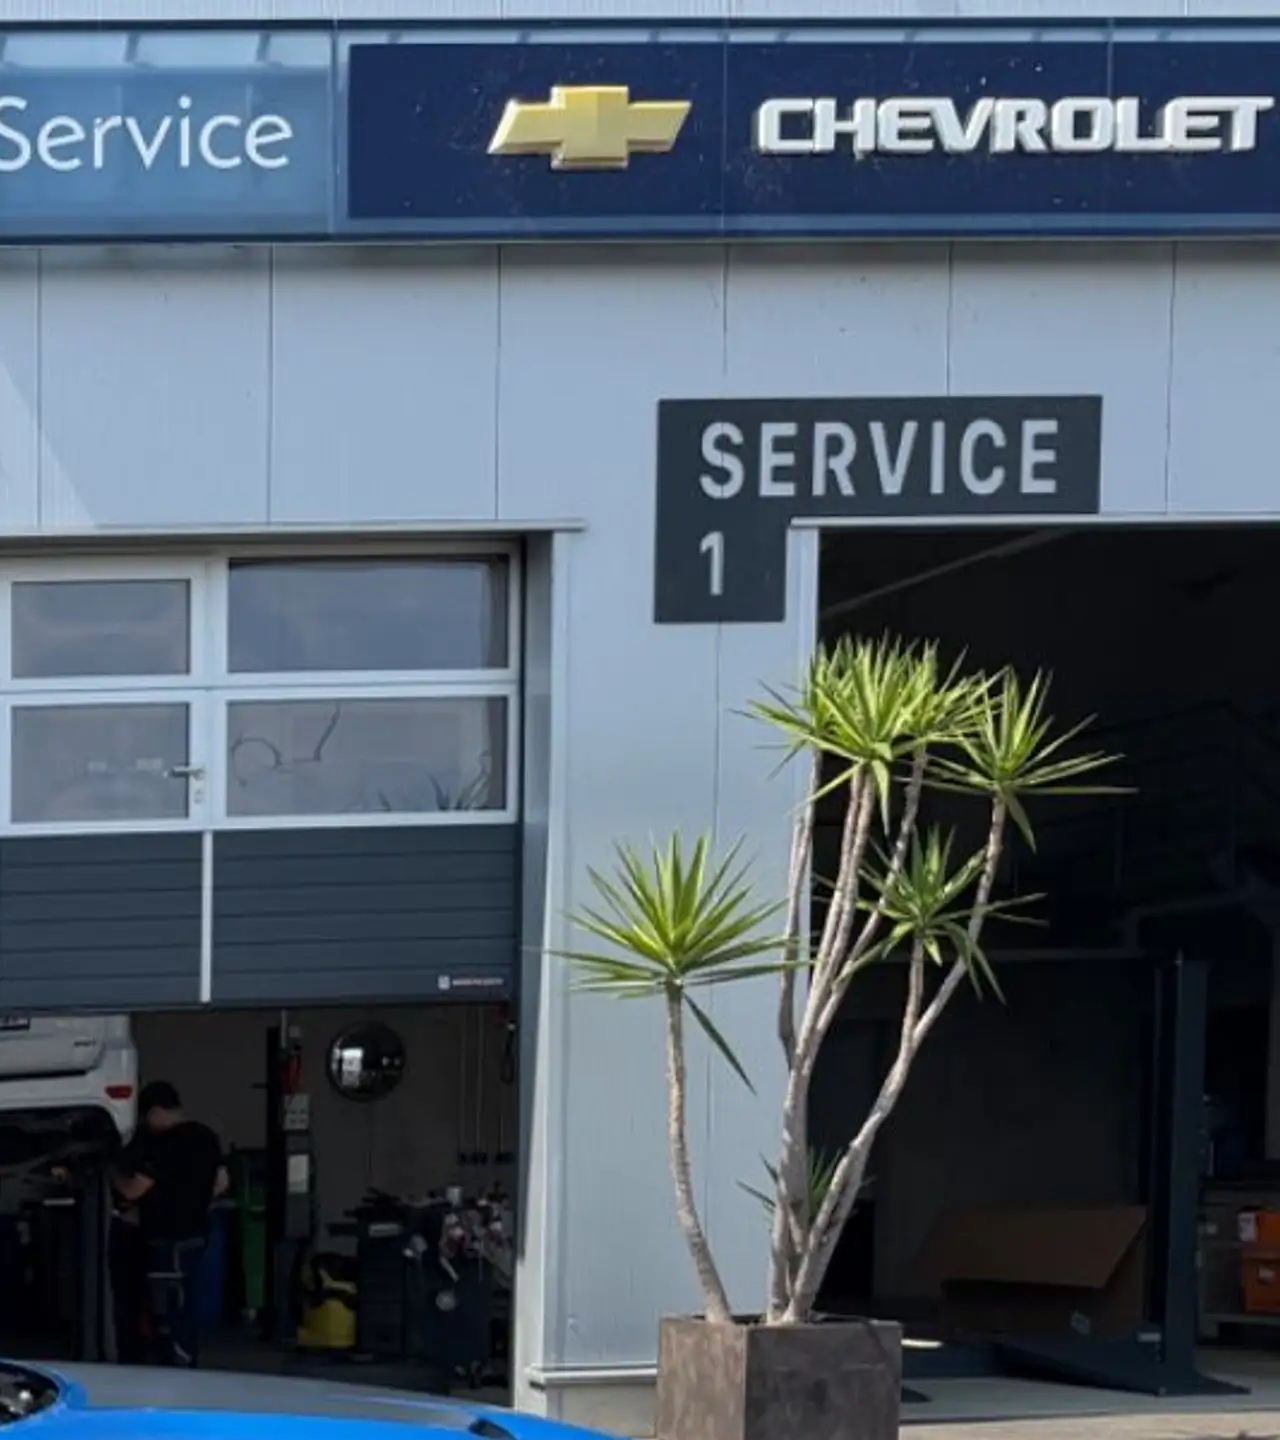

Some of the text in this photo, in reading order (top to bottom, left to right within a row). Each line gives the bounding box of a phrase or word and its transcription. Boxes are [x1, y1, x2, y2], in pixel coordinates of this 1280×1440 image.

[755, 96, 1276, 154] CHEVROLET
[698, 418, 1059, 499] SERVICE
[699, 531, 725, 596] 1
